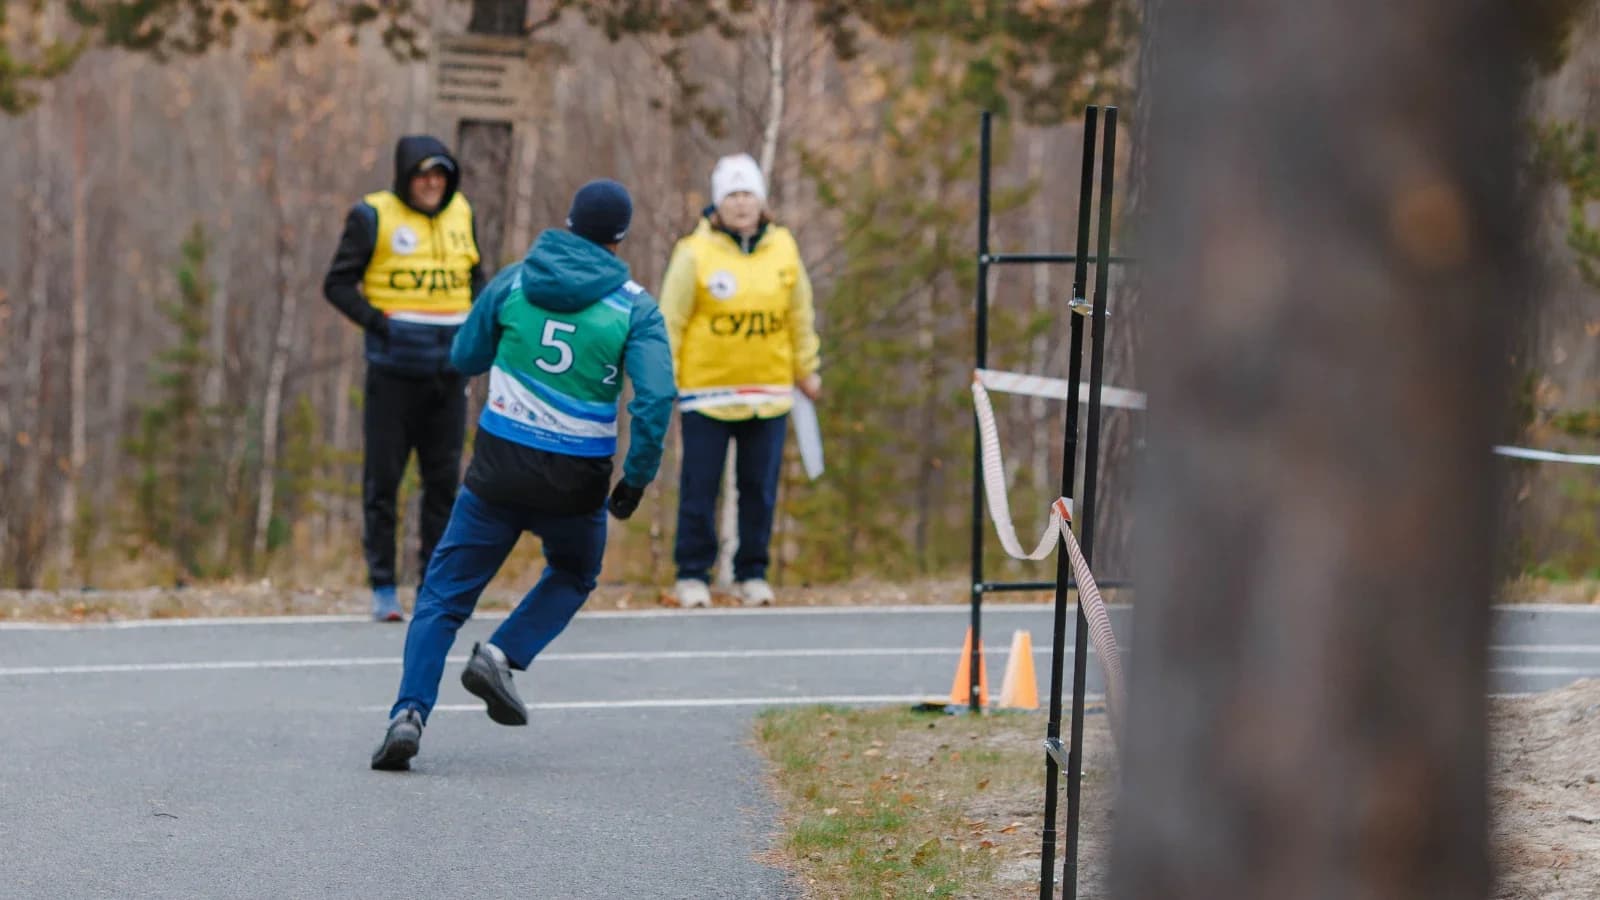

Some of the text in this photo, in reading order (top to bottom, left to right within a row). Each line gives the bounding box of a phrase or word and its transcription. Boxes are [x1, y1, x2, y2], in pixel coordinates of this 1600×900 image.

[389, 268, 469, 296] СУДЬ
[535, 319, 576, 374] 5
[602, 364, 618, 385] 2
